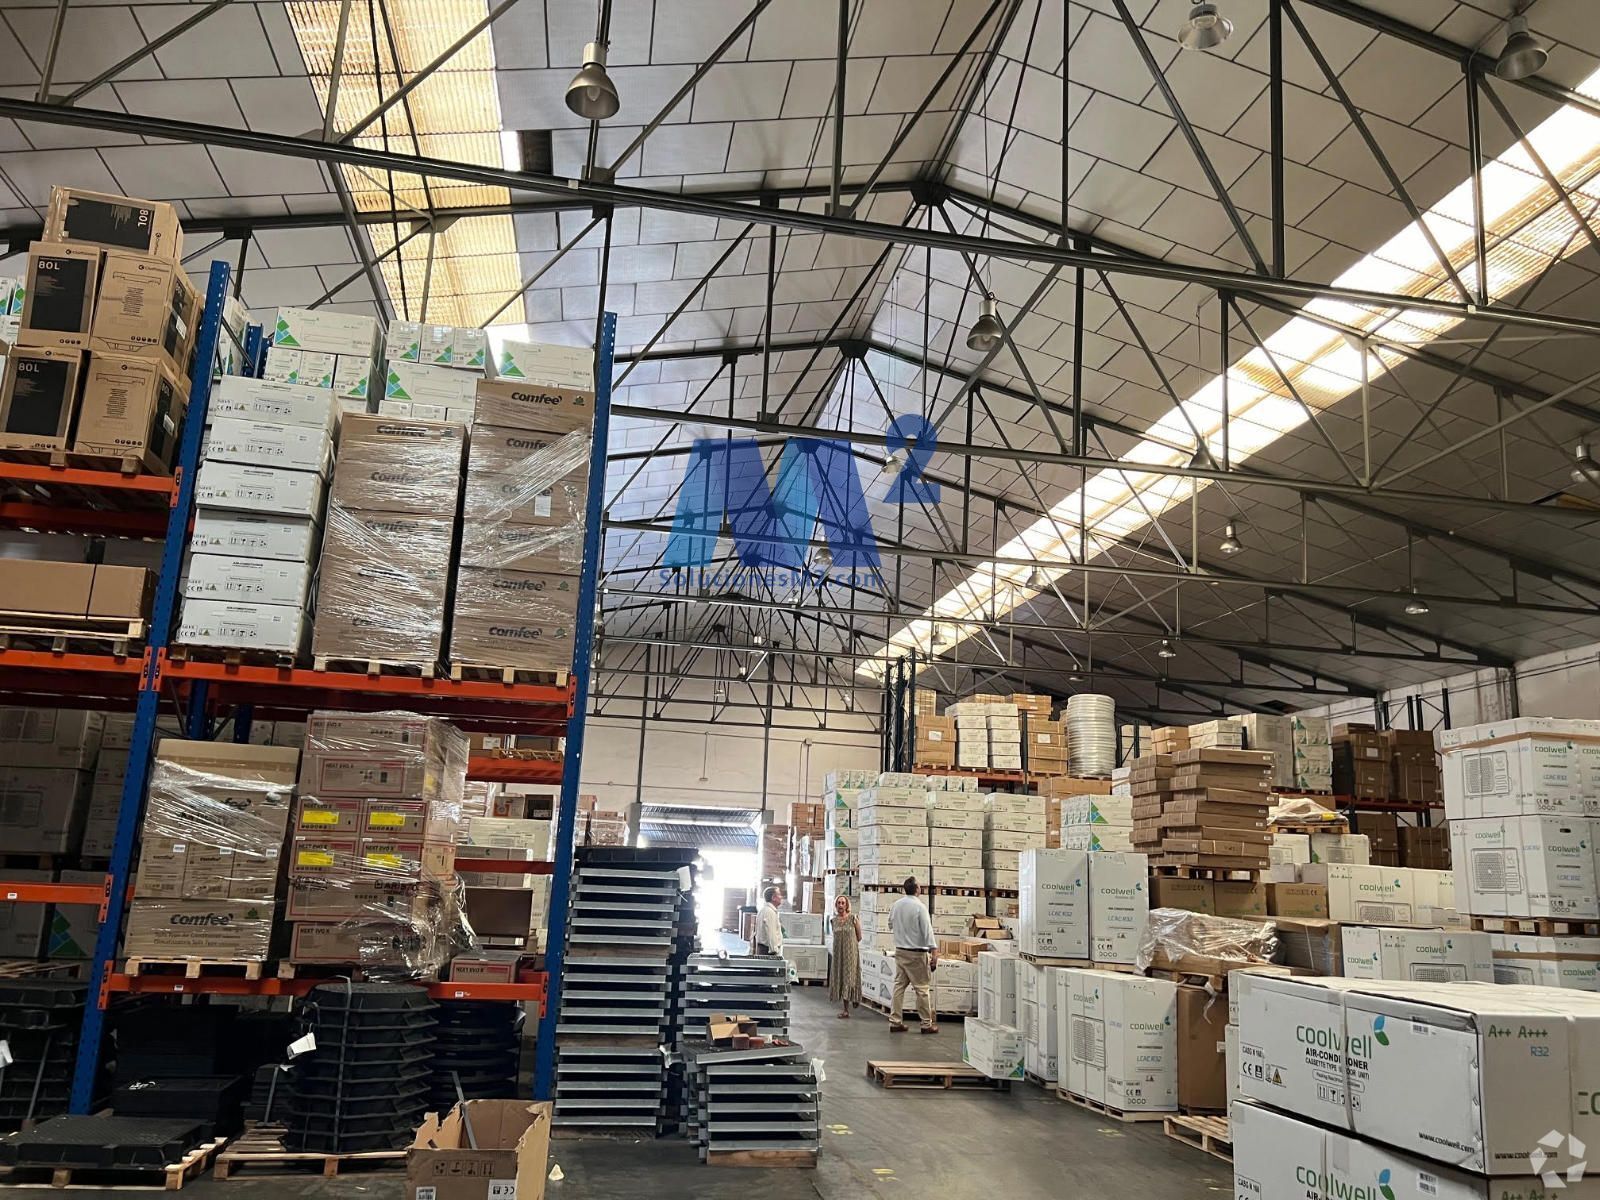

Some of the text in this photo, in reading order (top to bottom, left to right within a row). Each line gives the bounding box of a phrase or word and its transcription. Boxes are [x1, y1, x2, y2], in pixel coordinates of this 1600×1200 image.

[1360, 883, 1395, 892] coolwell
[1488, 1024, 1548, 1039] A++ A+++
[1296, 1025, 1372, 1060] coolwell
[1530, 1046, 1550, 1057] R32
[1305, 1047, 1369, 1071] AIR-CONDIIONER
[1418, 1131, 1475, 1154] www.coolwell.com
